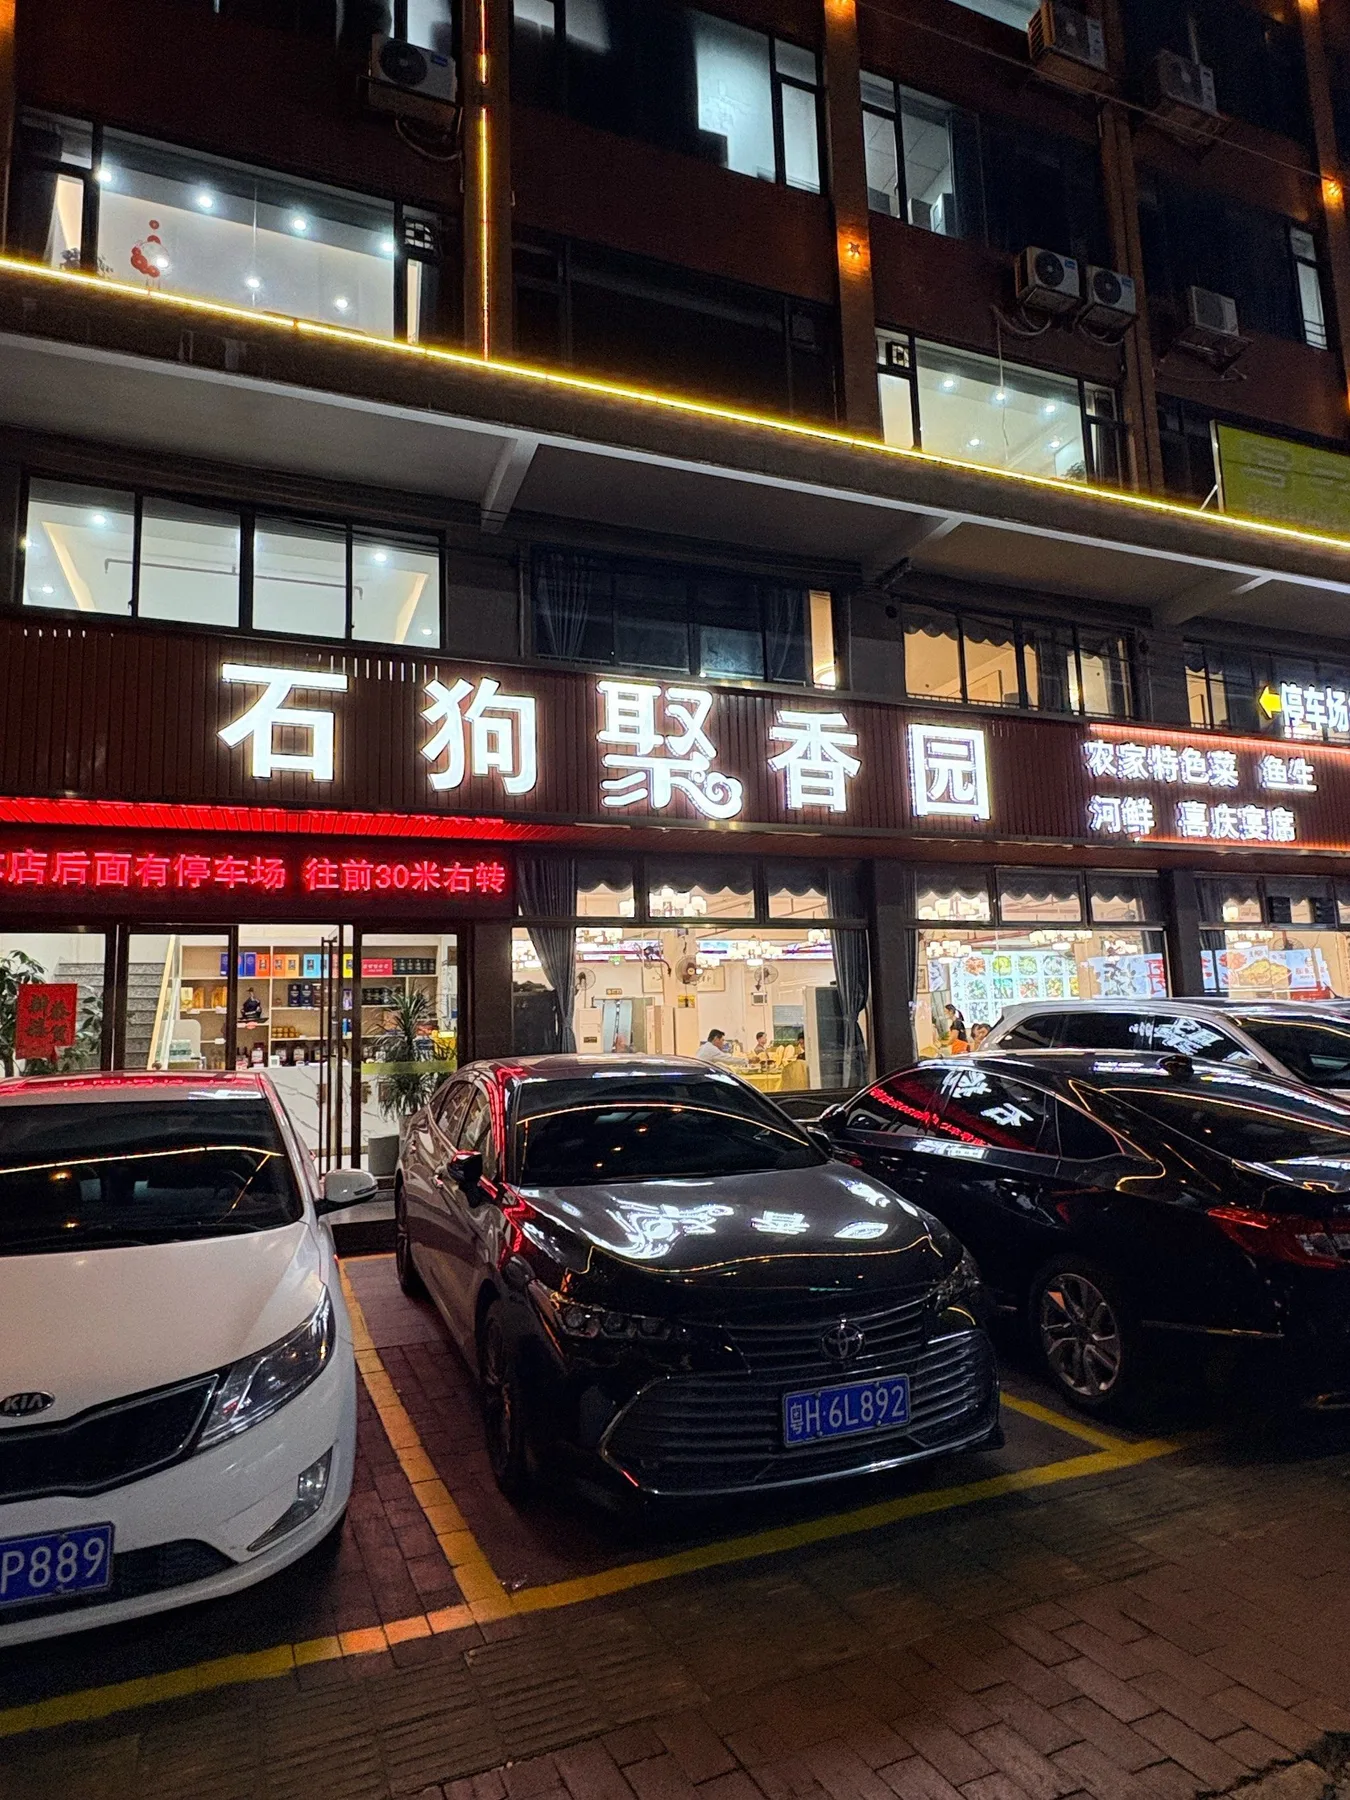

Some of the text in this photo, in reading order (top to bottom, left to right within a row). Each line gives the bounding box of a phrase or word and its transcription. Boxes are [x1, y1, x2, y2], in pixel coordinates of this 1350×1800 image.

[1280, 682, 1349, 732] 停车场
[217, 662, 992, 821] 石狗聚香园
[1085, 740, 1317, 791] 农家特色菜 鱼生
[1089, 795, 1296, 841] 河鲜 喜庆宴席
[0, 849, 506, 893] 店后面有停车场 往前30米右转
[4, 1394, 43, 1411] KIA
[0, 1538, 104, 1594] P889
